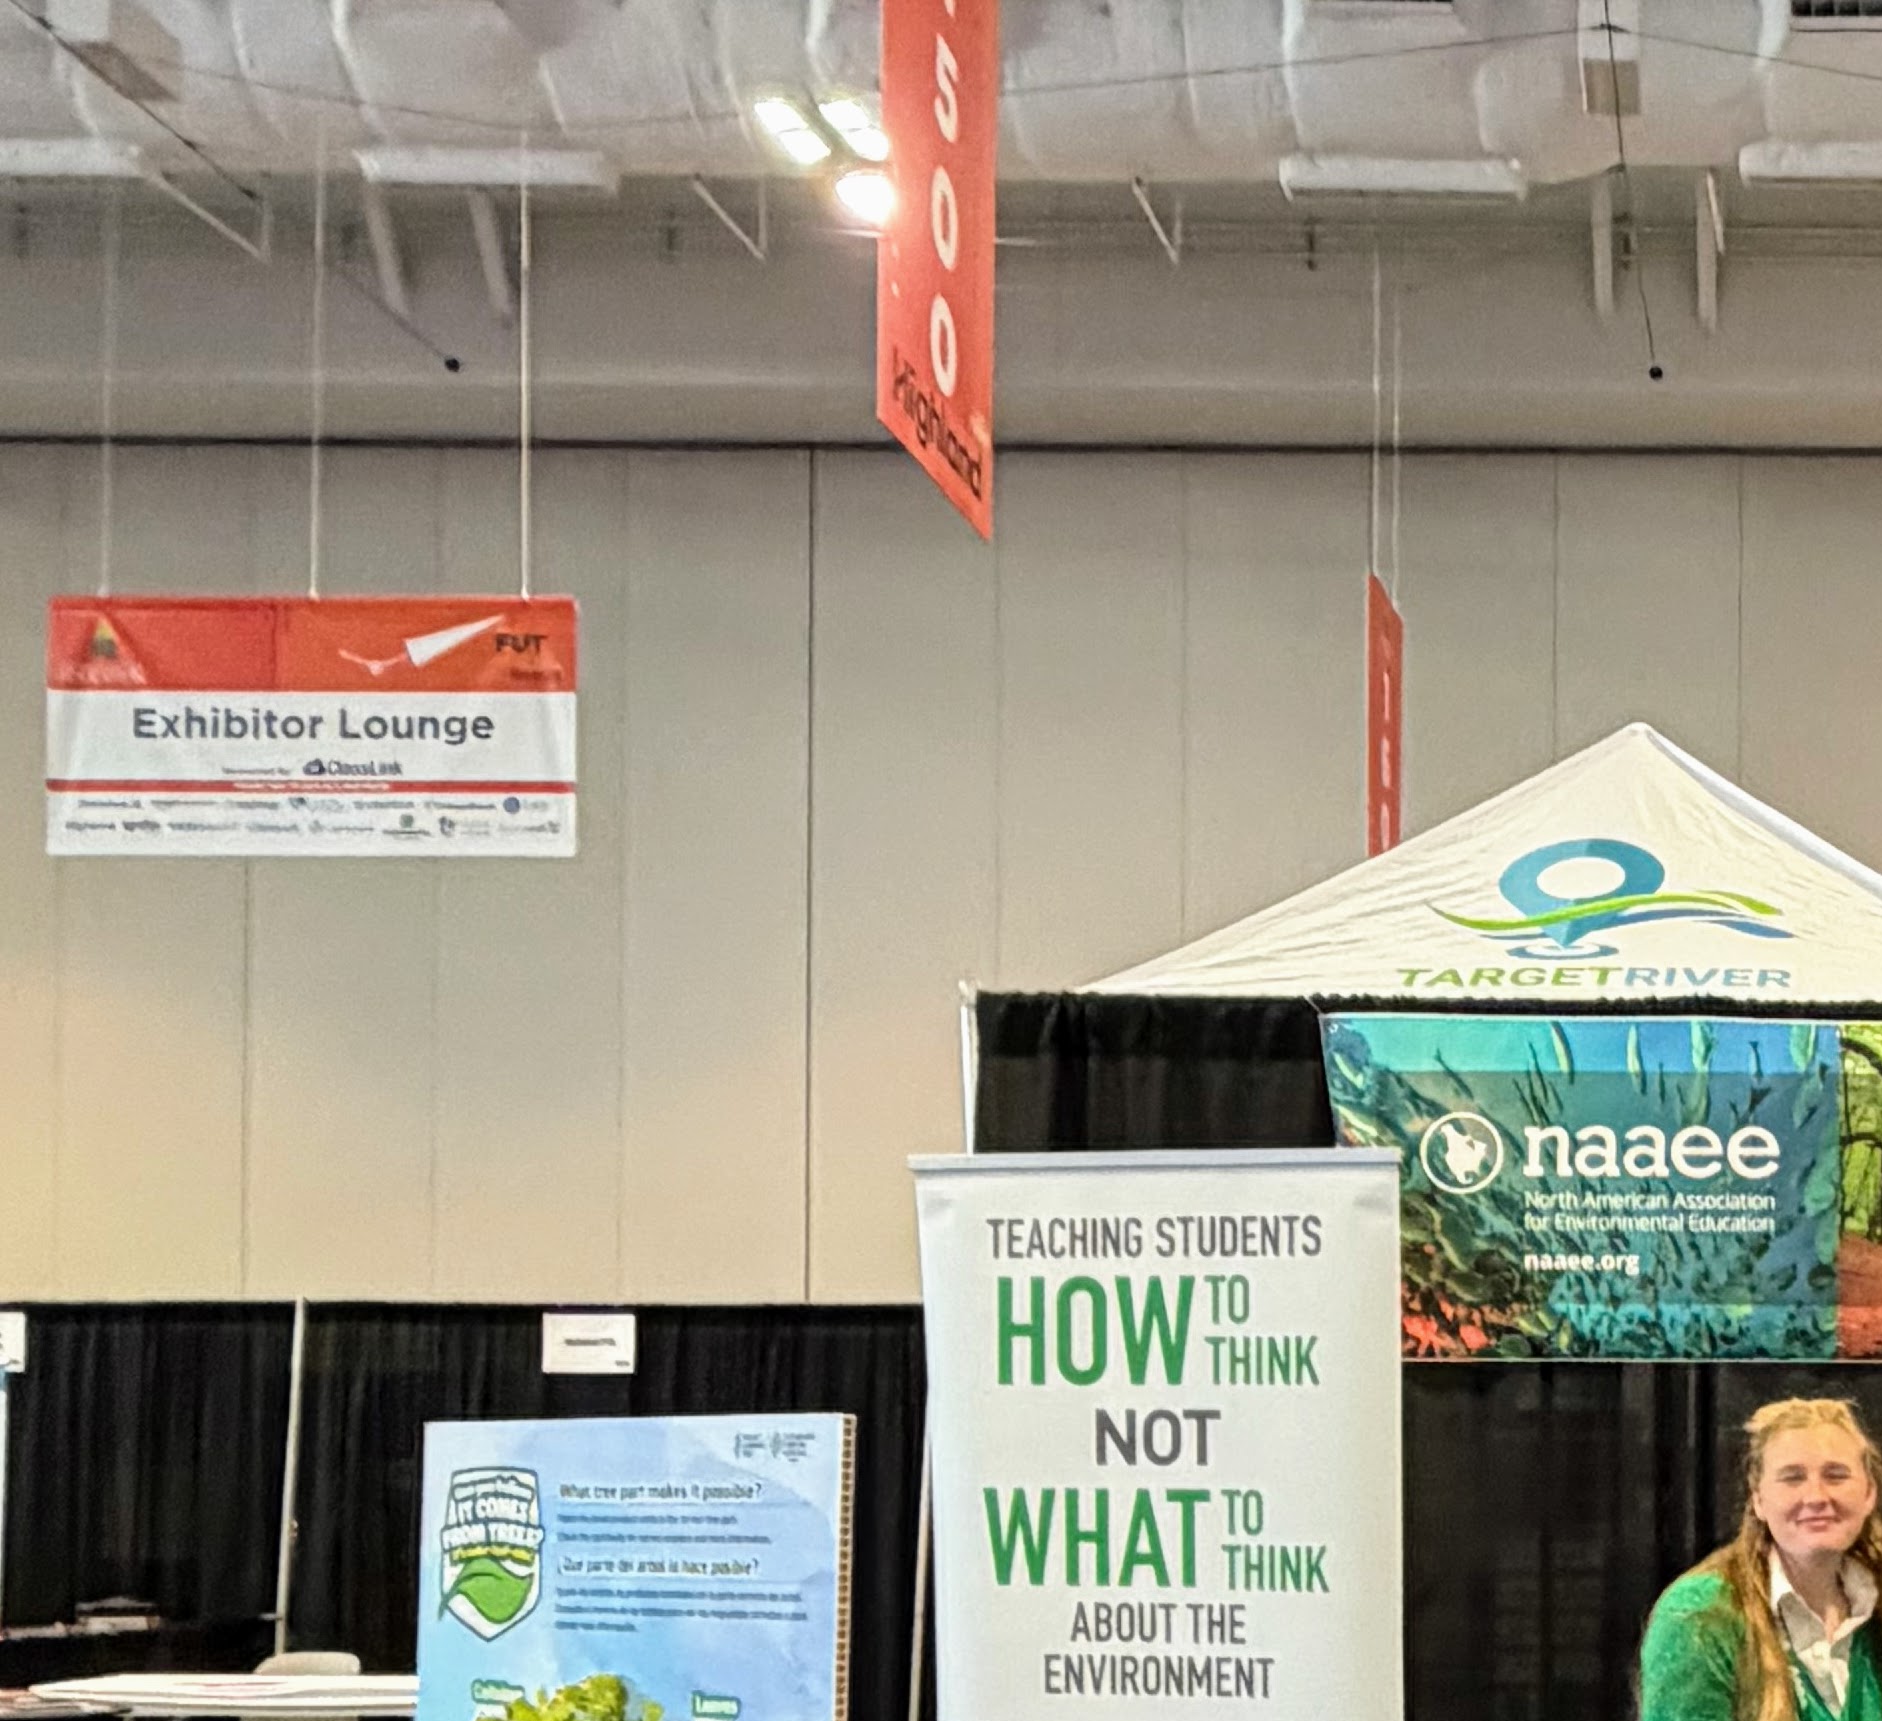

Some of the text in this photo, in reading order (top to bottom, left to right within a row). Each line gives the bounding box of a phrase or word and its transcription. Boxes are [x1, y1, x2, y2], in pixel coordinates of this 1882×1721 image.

[930, 0, 958, 398] 500
[133, 706, 496, 746] Exhibitor Lounge
[1396, 966, 1791, 989] TARGETRIVER
[1522, 1123, 1781, 1180] naaee
[1524, 1190, 1776, 1211] North American Association
[1524, 1213, 1776, 1233] for Environmental Education
[986, 1214, 1323, 1260] TEACHING STUDENTS
[1524, 1254, 1641, 1277] naaee.org
[997, 1273, 1250, 1386] HOW TO
[1204, 1334, 1320, 1387] THINK
[1095, 1408, 1222, 1467] NOT
[983, 1487, 1265, 1588] WHAT TO
[1221, 1543, 1331, 1594] THINK
[1070, 1602, 1247, 1646] ABOUT THE
[1043, 1653, 1276, 1700] ENVIRONMENT
